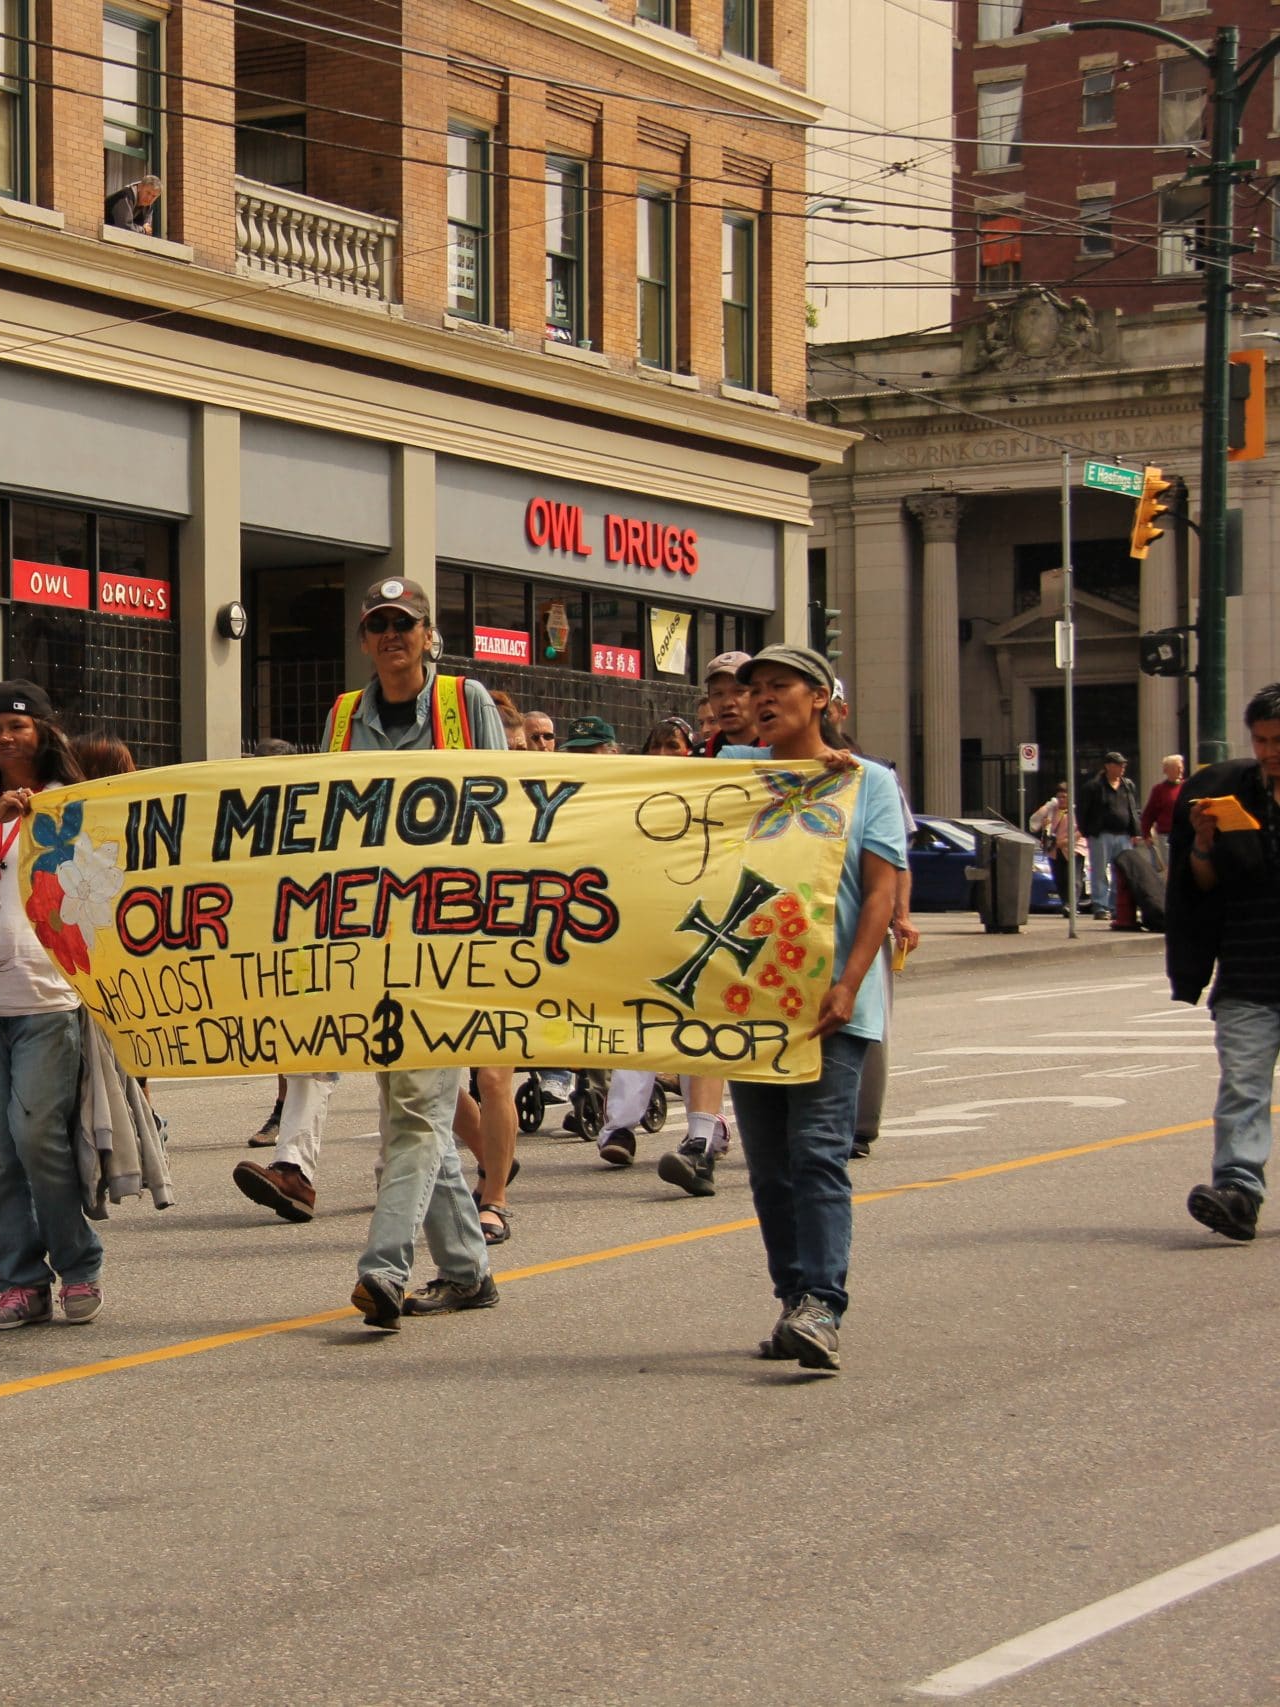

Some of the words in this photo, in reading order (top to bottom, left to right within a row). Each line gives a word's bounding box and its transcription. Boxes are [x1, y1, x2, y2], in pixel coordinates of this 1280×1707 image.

[1087, 465, 1096, 481] E
[1097, 466, 1131, 491] Hastings
[525, 496, 593, 556] OWL
[604, 513, 699, 576] DRUGS
[30, 571, 73, 599] OWL
[102, 582, 167, 611] DRUGS
[474, 635, 527, 657] PHARMACY
[125, 793, 187, 872] IN
[211, 776, 586, 863] MEMORY
[116, 881, 234, 957] OUR
[272, 866, 620, 966] MEMBERS
[142, 954, 216, 1017] LOST
[230, 942, 361, 1000] THEIR
[384, 940, 541, 990] LIVES
[118, 1030, 152, 1068] TO
[147, 1025, 197, 1068] THE
[195, 1016, 279, 1068] DRUG
[280, 1014, 370, 1066] WAR
[411, 1008, 535, 1059] WAR
[535, 999, 596, 1024] ON
[573, 1022, 629, 1054] THE
